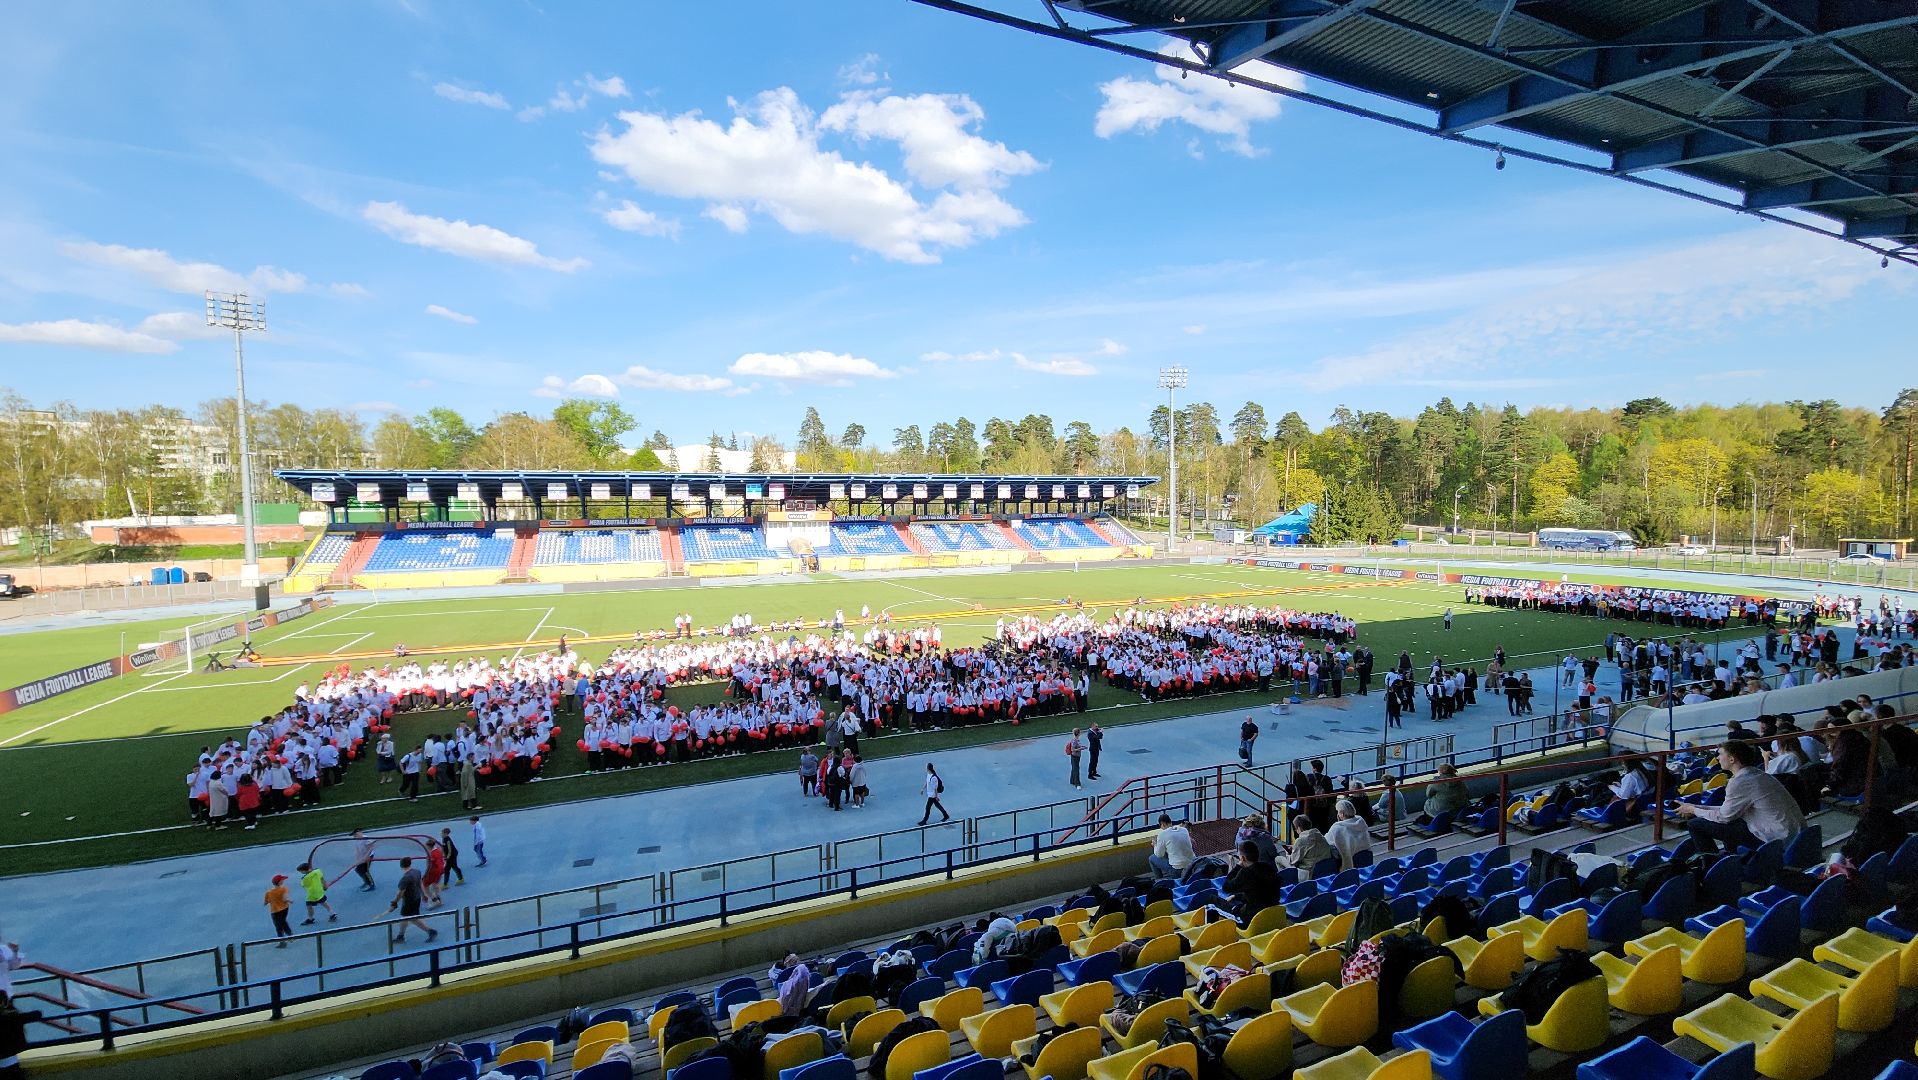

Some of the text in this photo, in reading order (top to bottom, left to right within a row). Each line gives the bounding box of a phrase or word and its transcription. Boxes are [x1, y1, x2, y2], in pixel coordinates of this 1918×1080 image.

[1461, 575, 1480, 584] MEDIA
[1481, 576, 1512, 587] FOOTBALL
[15, 662, 113, 705] MEDIA FOOTBALL LEAGUE
